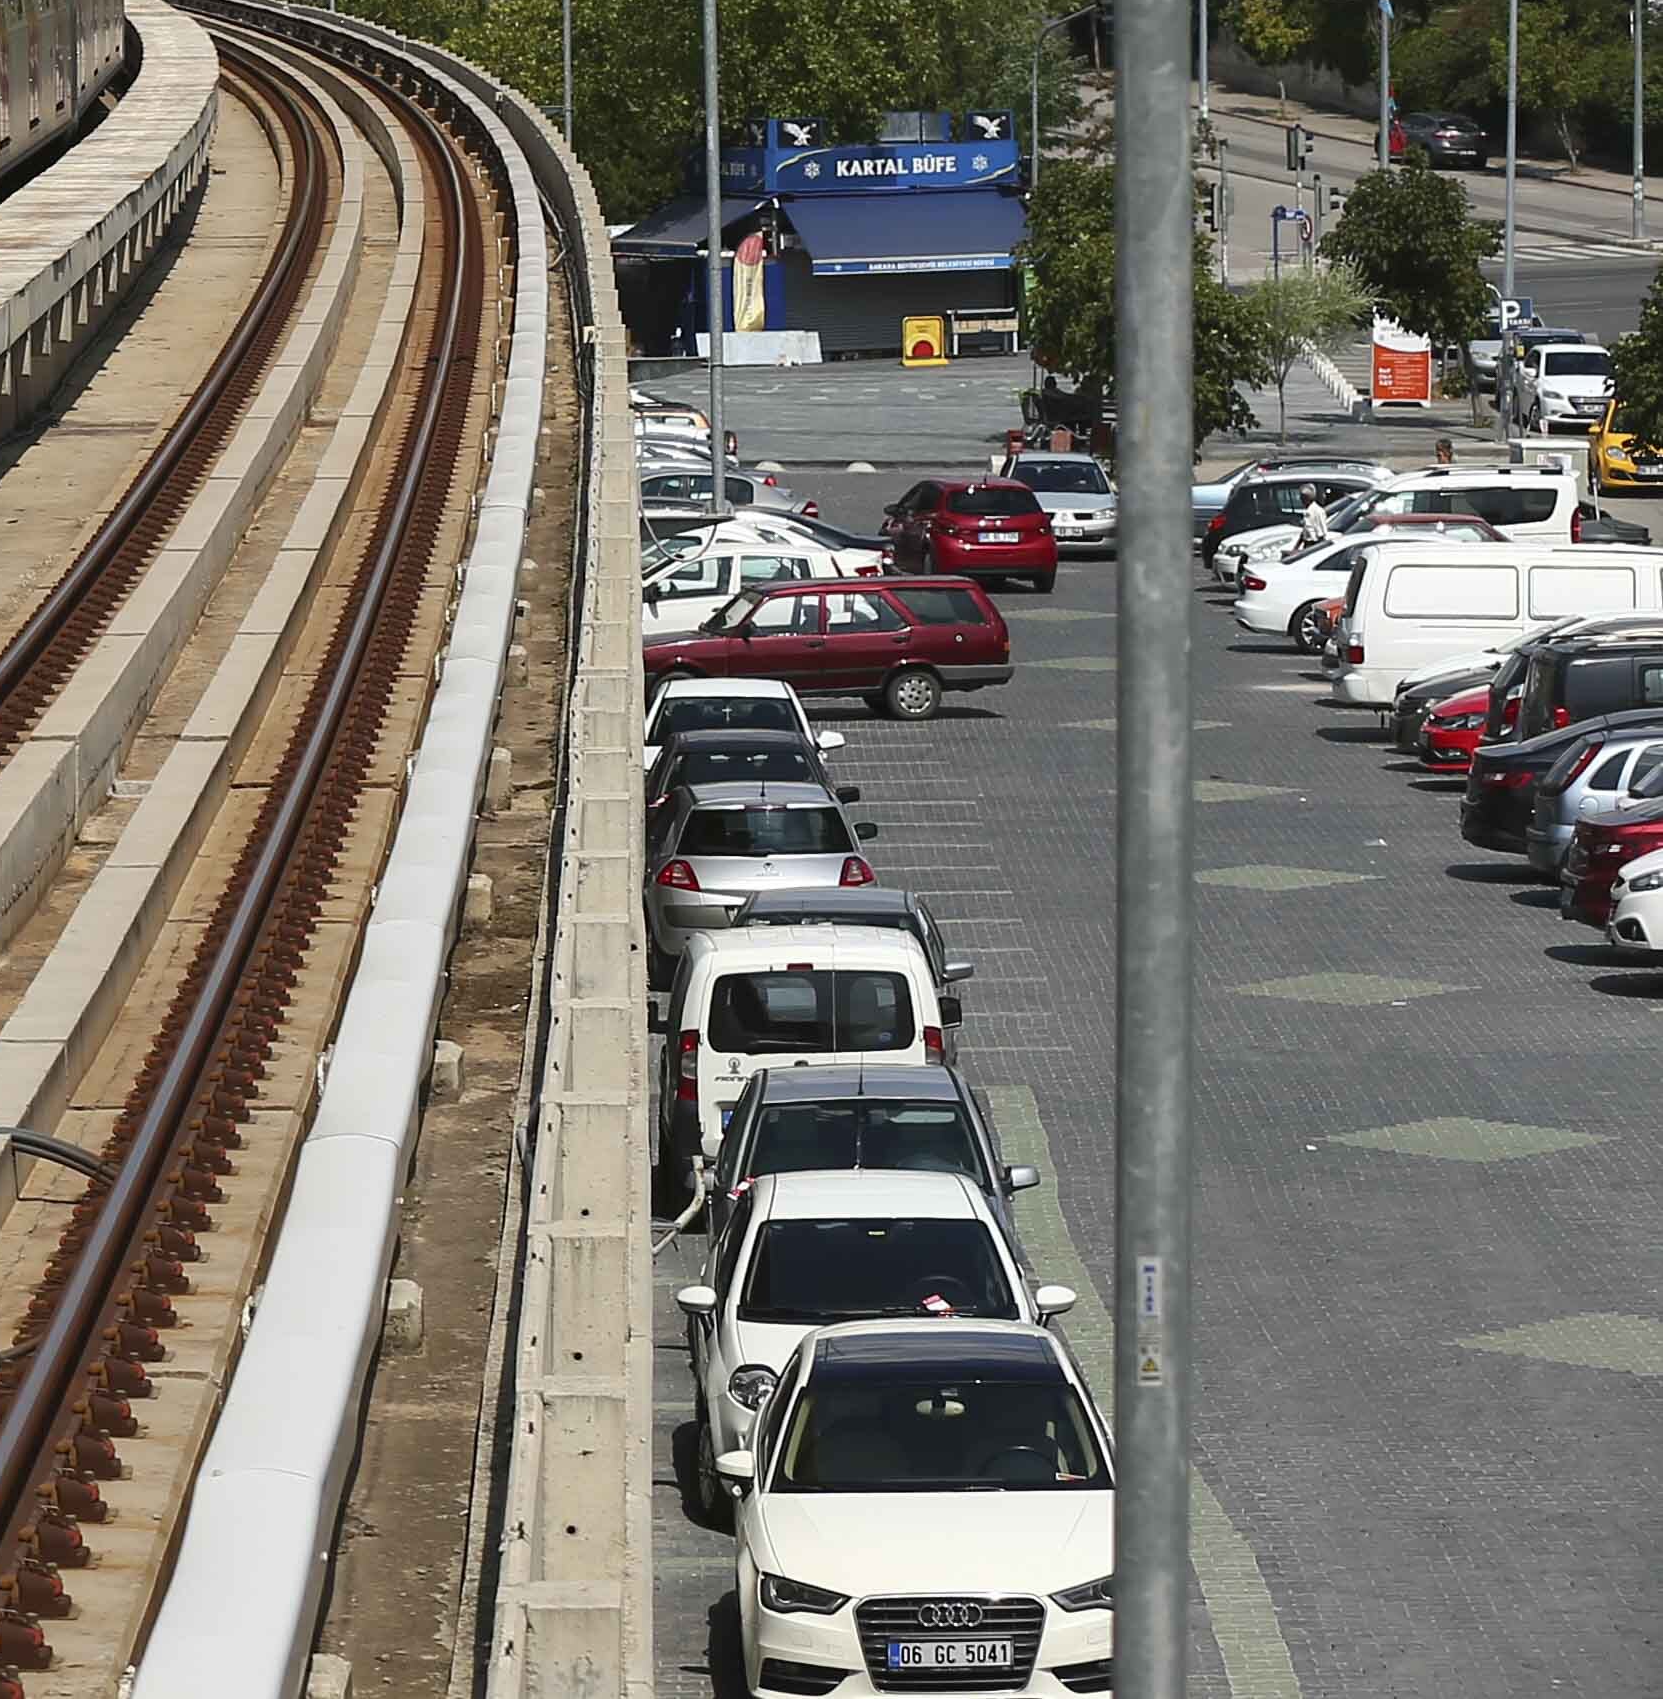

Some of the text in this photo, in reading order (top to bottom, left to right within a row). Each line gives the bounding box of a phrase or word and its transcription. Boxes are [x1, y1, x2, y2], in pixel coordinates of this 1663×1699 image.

[836, 154, 957, 177] KARTAL BÜFE
[1501, 300, 1521, 330] P
[901, 1646, 923, 1665] 06
[934, 1645, 956, 1664] GC
[965, 1643, 1008, 1663] 5041
